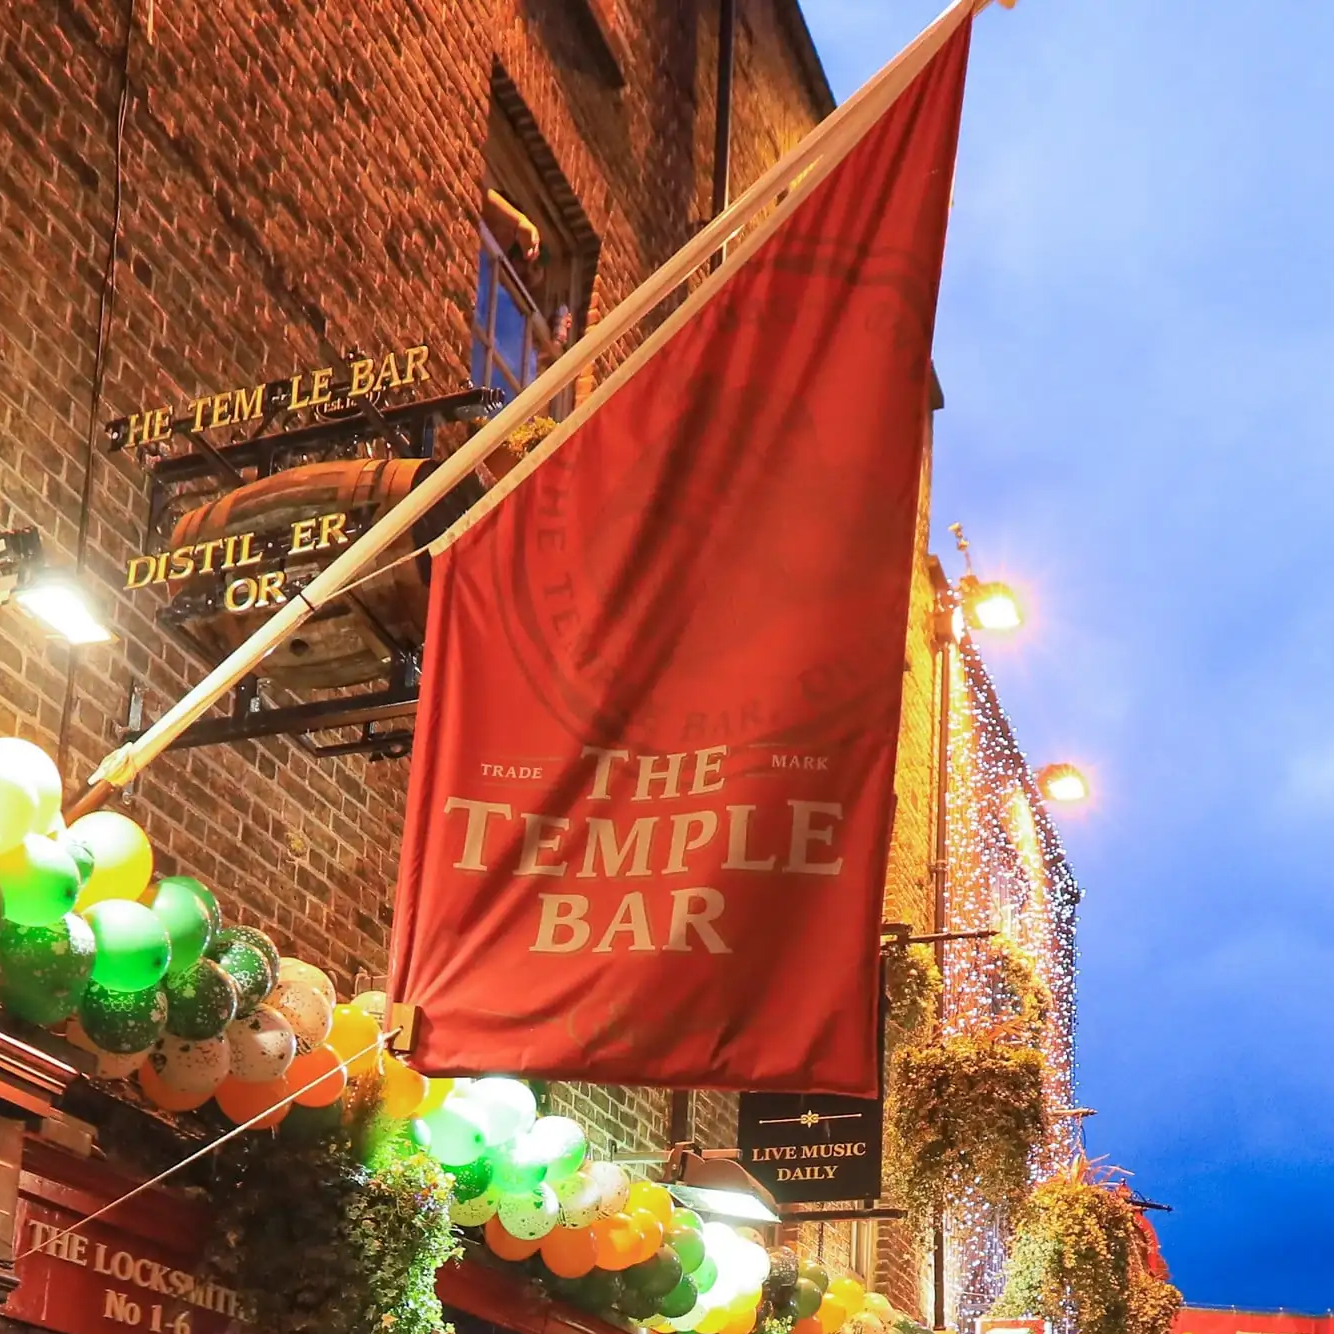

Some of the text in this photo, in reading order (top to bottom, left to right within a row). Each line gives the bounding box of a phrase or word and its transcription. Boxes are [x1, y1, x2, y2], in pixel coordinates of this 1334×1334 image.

[348, 345, 431, 398] BAR
[481, 762, 543, 779] TRADE
[582, 745, 728, 801] THE
[771, 754, 829, 771] MARK
[444, 796, 844, 878] TEMPLE
[529, 887, 733, 954] BAR
[752, 1142, 866, 1163] LIVE MUSIC
[776, 1164, 838, 1182] DAILY
[28, 1219, 87, 1266] THE
[102, 1289, 140, 1325] No
